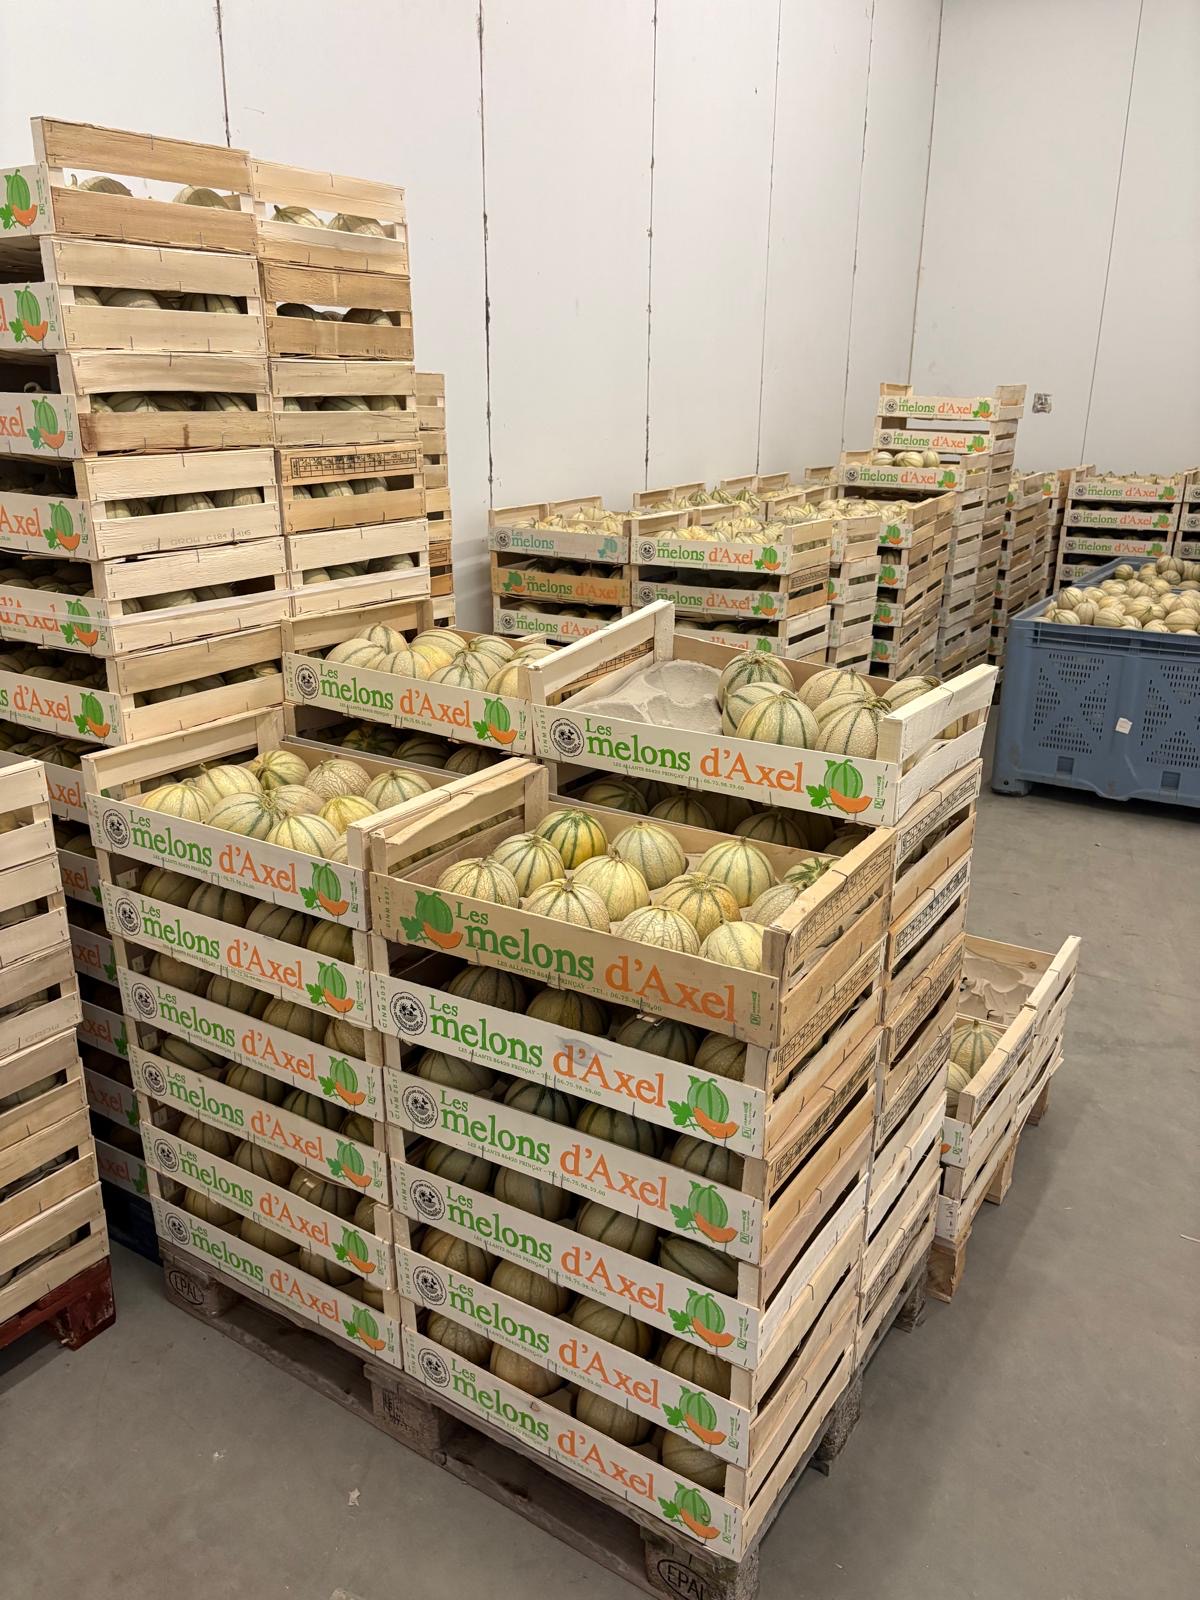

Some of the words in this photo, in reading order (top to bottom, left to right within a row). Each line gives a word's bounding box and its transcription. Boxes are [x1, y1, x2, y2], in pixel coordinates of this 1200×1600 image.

[899, 402, 935, 413] melons
[938, 404, 972, 415] d'Axel
[0, 406, 27, 437] xel
[893, 435, 929, 446] melons
[932, 436, 966, 449] d'Axel
[860, 471, 898, 482] melons
[900, 472, 937, 485] d'Axel
[1088, 487, 1122, 496] melons
[1125, 488, 1158, 497] d'Axel
[0, 506, 43, 538] Axel
[1083, 515, 1118, 526] melons
[1120, 516, 1152, 526] d'Axel
[511, 535, 554, 550] melons
[657, 544, 704, 561] melons
[708, 547, 753, 565] d'Axel
[1078, 542, 1112, 552] melons
[1114, 543, 1147, 553] d'Axel
[527, 579, 573, 595] melons
[575, 582, 620, 600] d'Axel
[706, 592, 751, 610] d'Axel
[516, 618, 558, 633] melons
[320, 663, 338, 680] Les
[13, 685, 74, 723] d'Axel
[320, 677, 393, 710] melons
[400, 688, 472, 729] d'Axel
[584, 718, 612, 736] Les
[586, 735, 691, 772] melons
[700, 748, 804, 793] d'Axel
[46, 775, 82, 808] xel
[129, 810, 151, 828] Les
[131, 828, 212, 867] melons
[219, 845, 298, 895] d'Axel
[62, 865, 90, 891] xel
[140, 900, 161, 919] Les
[456, 902, 489, 925] Les
[77, 944, 101, 968] xel
[143, 917, 220, 959] melons
[226, 939, 304, 991] d'Axel
[465, 926, 594, 981] melons
[605, 955, 737, 1024] d'Axel
[157, 986, 177, 1004] Les
[429, 994, 458, 1017] Les
[81, 1019, 113, 1044] xel
[158, 1002, 236, 1048] melons
[241, 1029, 317, 1082] d'Axel
[430, 1014, 543, 1068] melons
[553, 1045, 667, 1108] d'Axel
[166, 1065, 186, 1085] Les
[440, 1089, 469, 1113] Les
[168, 1080, 244, 1127] melons
[250, 1110, 325, 1162] d'Axel
[178, 1143, 198, 1162] Les
[441, 1108, 550, 1165] melons
[559, 1143, 668, 1211] d'Axel
[180, 1159, 254, 1208] melons
[259, 1192, 331, 1247] d'Axel
[446, 1185, 473, 1209] Les
[189, 1219, 208, 1237] Les
[447, 1202, 552, 1264] melons
[560, 1246, 666, 1315] d'Axel
[190, 1231, 263, 1283] melons
[269, 1269, 341, 1324] d'Axel
[448, 1273, 474, 1297] Les
[449, 1291, 549, 1354] melons
[558, 1339, 661, 1409] d'Axel
[451, 1358, 476, 1382] Les
[452, 1374, 549, 1442] melons
[557, 1429, 656, 1502] d'Axel
